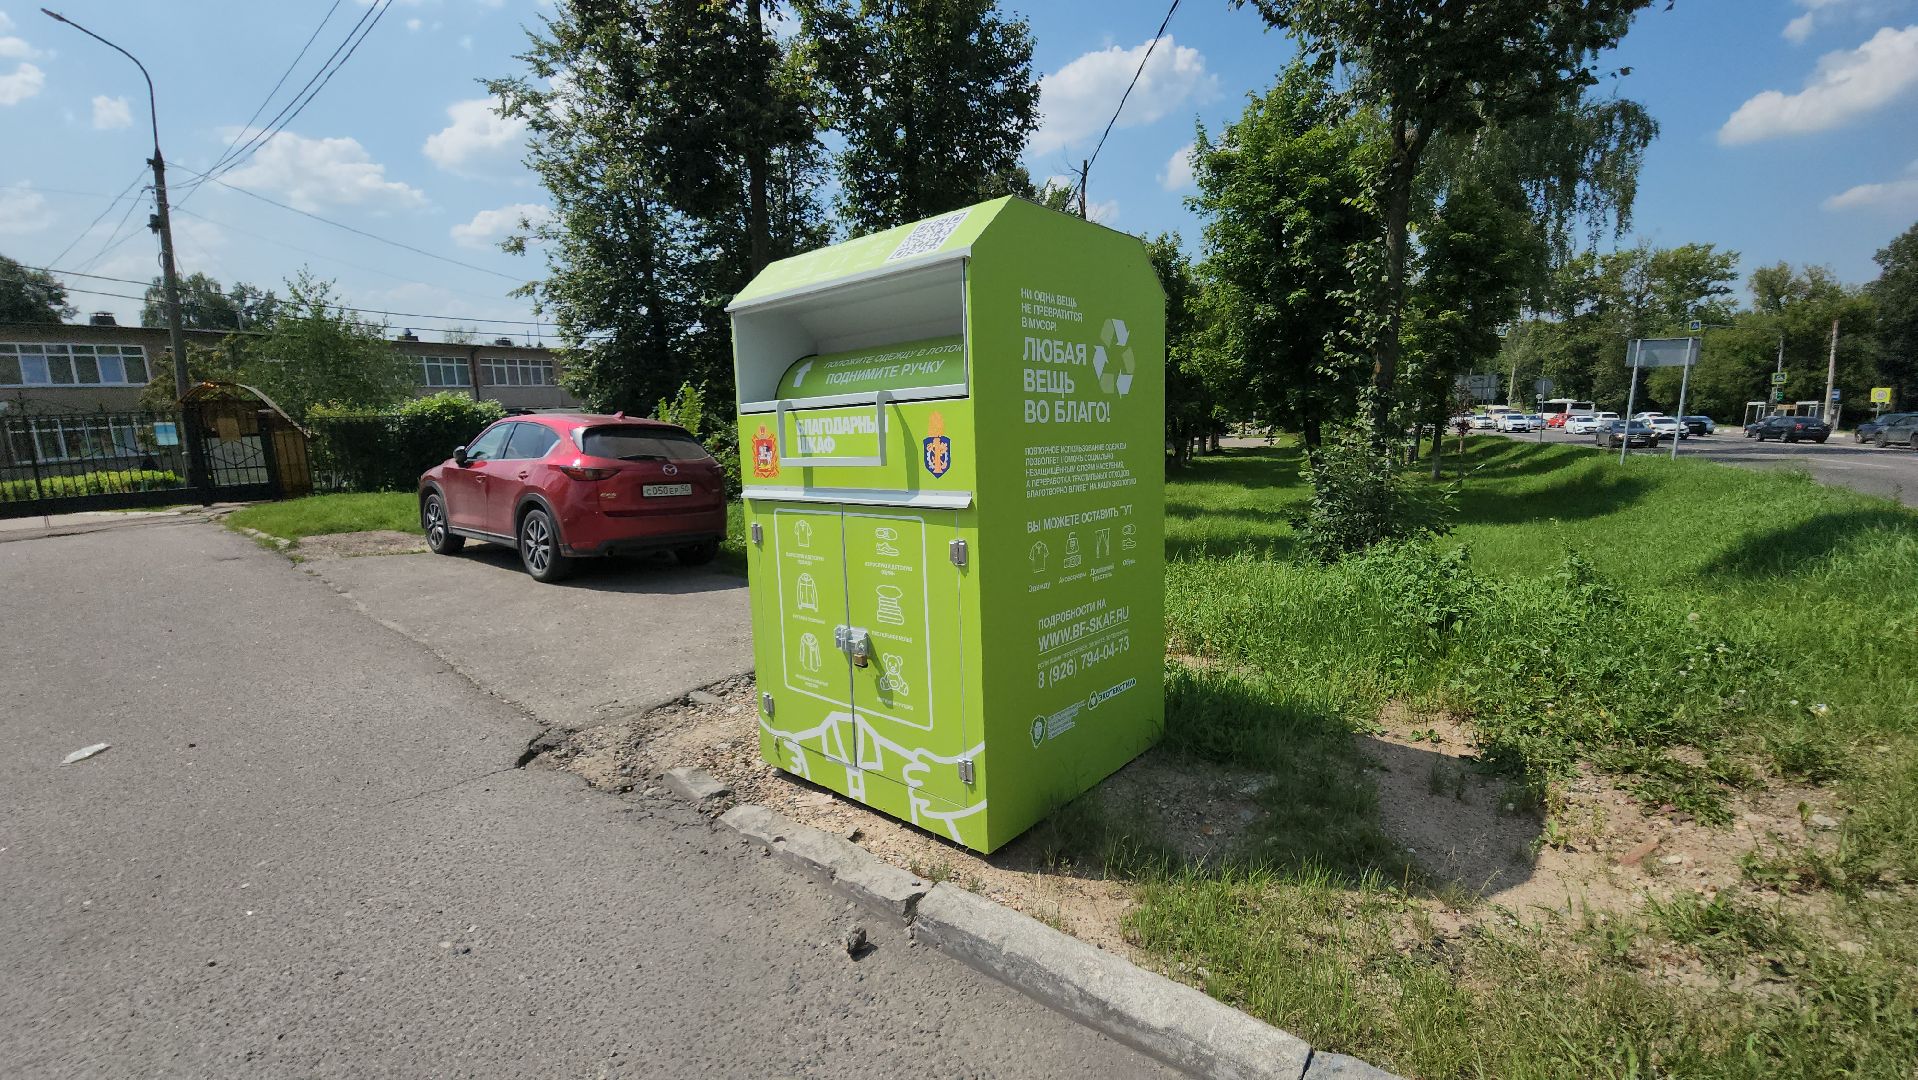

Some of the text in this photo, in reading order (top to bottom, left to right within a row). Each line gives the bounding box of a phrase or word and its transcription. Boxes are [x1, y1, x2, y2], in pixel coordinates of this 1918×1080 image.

[1021, 288, 1077, 309] НИ ОДНА ВЕЩЬ
[1021, 302, 1083, 323] НЕ ПРЕВРАТИТСЯ
[1021, 316, 1027, 328] В
[824, 356, 875, 368] ПОЛОЖИТЕ
[874, 351, 916, 363] ОДЕЖДУ
[926, 344, 964, 355] ЛОТОК
[1023, 337, 1087, 365] ЛЮБАЯ
[826, 360, 945, 385] ПОДНИМИТЕ РУЧКУ
[1024, 368, 1075, 398] ВЕЩЬ
[1024, 400, 1111, 424] ВО БЛАГО!
[798, 436, 836, 453] ШКАФ
[1027, 520, 1041, 534] ВЫ
[1043, 513, 1080, 530] МОЖЕТЕ
[1081, 507, 1119, 524] ОСТАВИТЬ
[1038, 598, 1107, 630] ПОДРОБНОСТИ НА
[1038, 606, 1130, 652] WWW.BF-SKAF.RU
[1038, 671, 1045, 689] 8
[1049, 657, 1078, 688] (926)
[1080, 635, 1130, 670] 794-04-73
